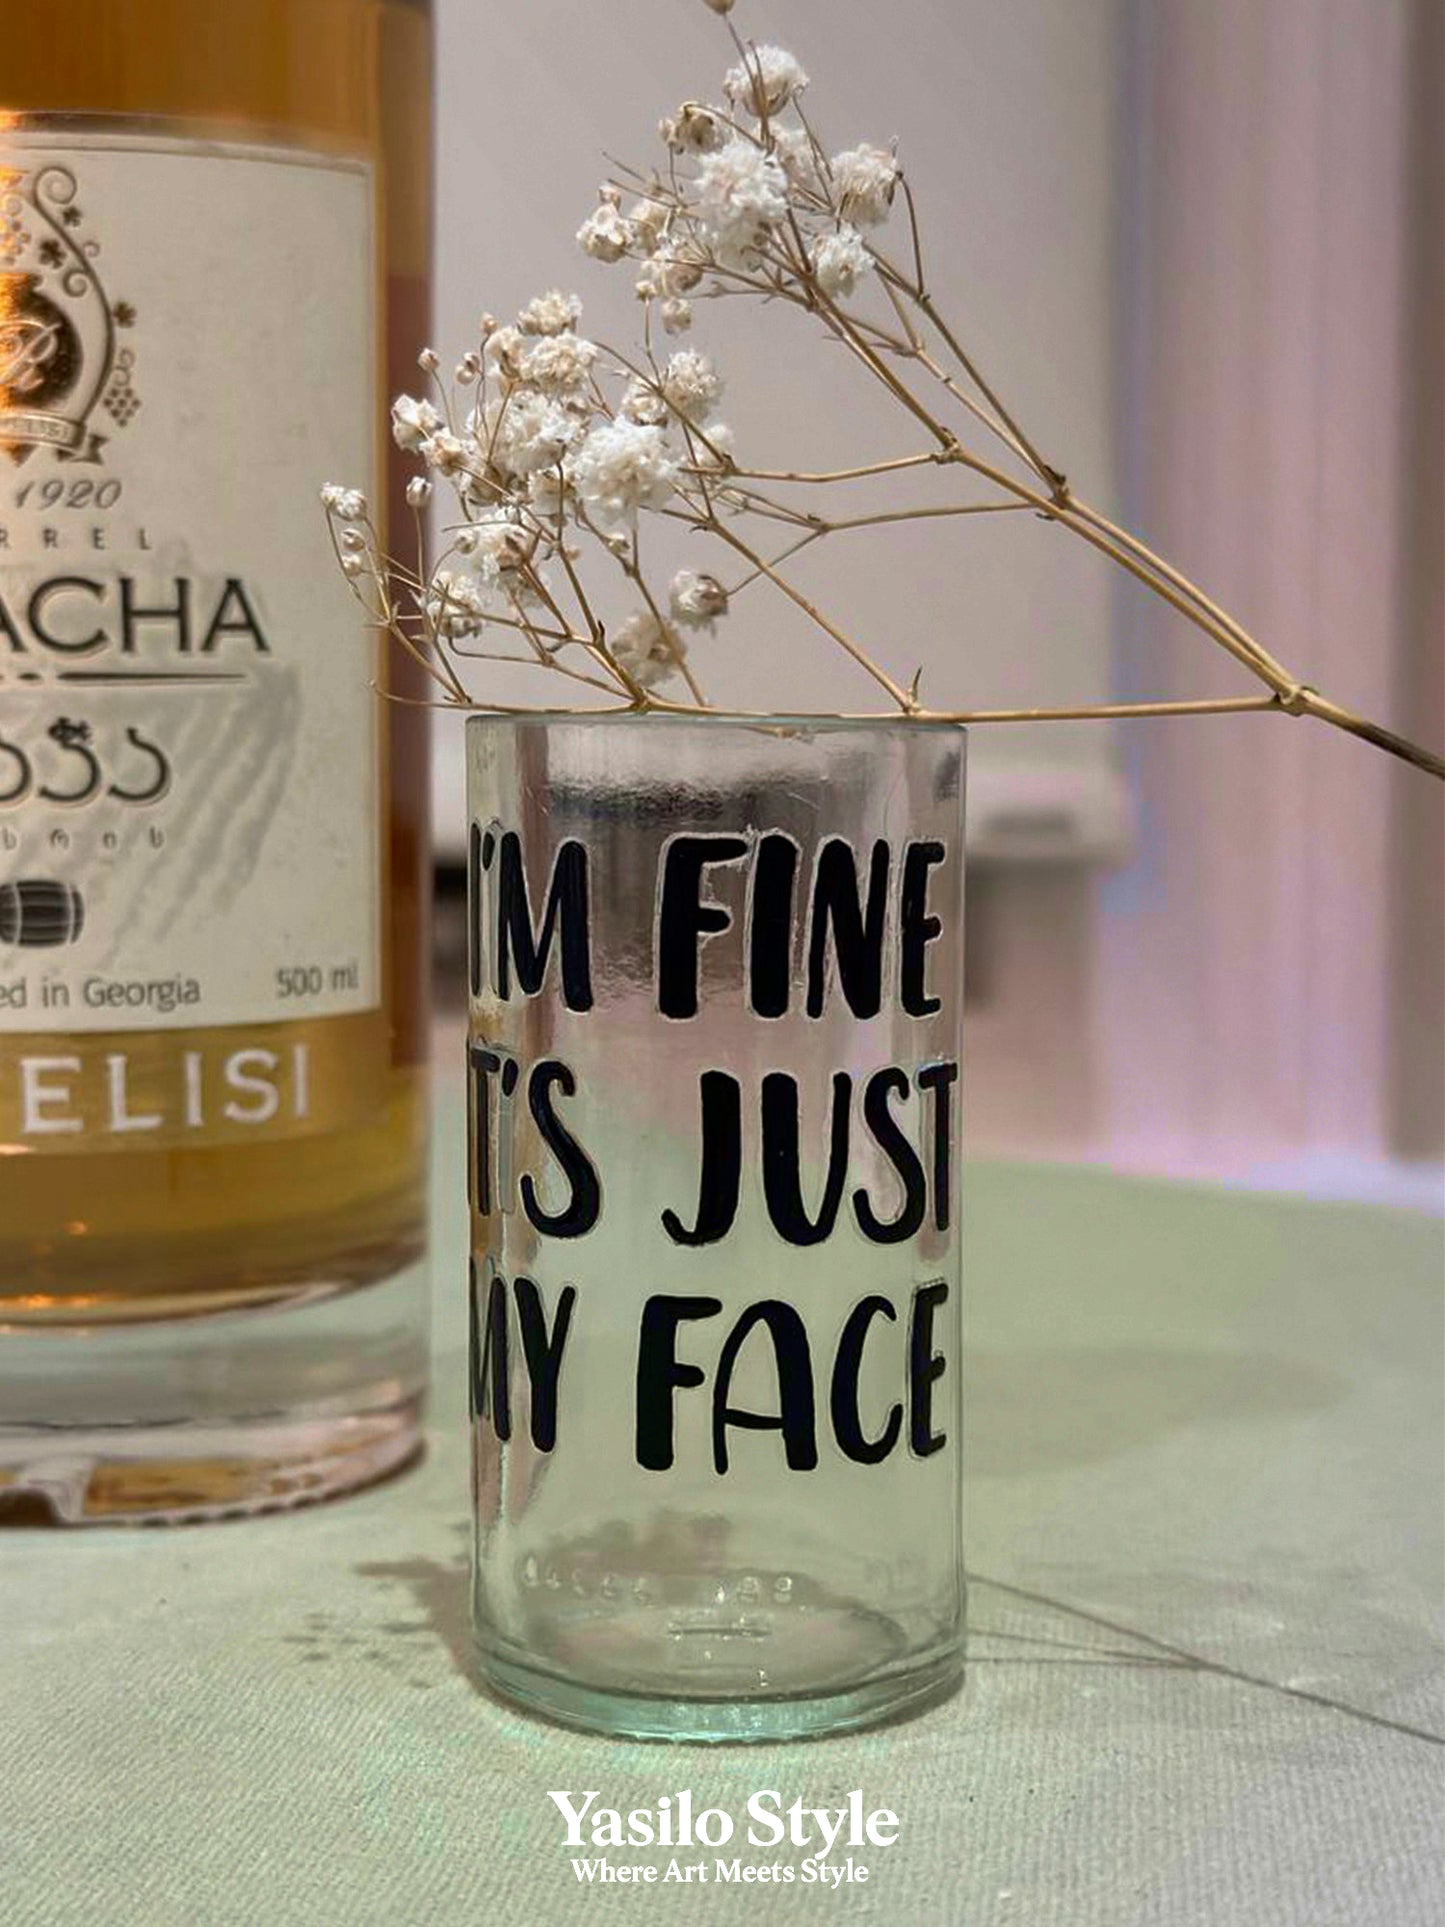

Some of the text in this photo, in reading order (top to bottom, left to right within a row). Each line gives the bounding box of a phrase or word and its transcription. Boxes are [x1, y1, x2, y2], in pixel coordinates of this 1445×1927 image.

[15, 479, 123, 511] 1920
[658, 834, 946, 1020] FINE
[41, 975, 71, 1009] in
[83, 971, 201, 1014] Georgia
[277, 966, 322, 997] 500
[19, 1043, 308, 1135] ELISI
[467, 1046, 958, 1246] T'S JUST
[635, 1282, 949, 1476] FACE
